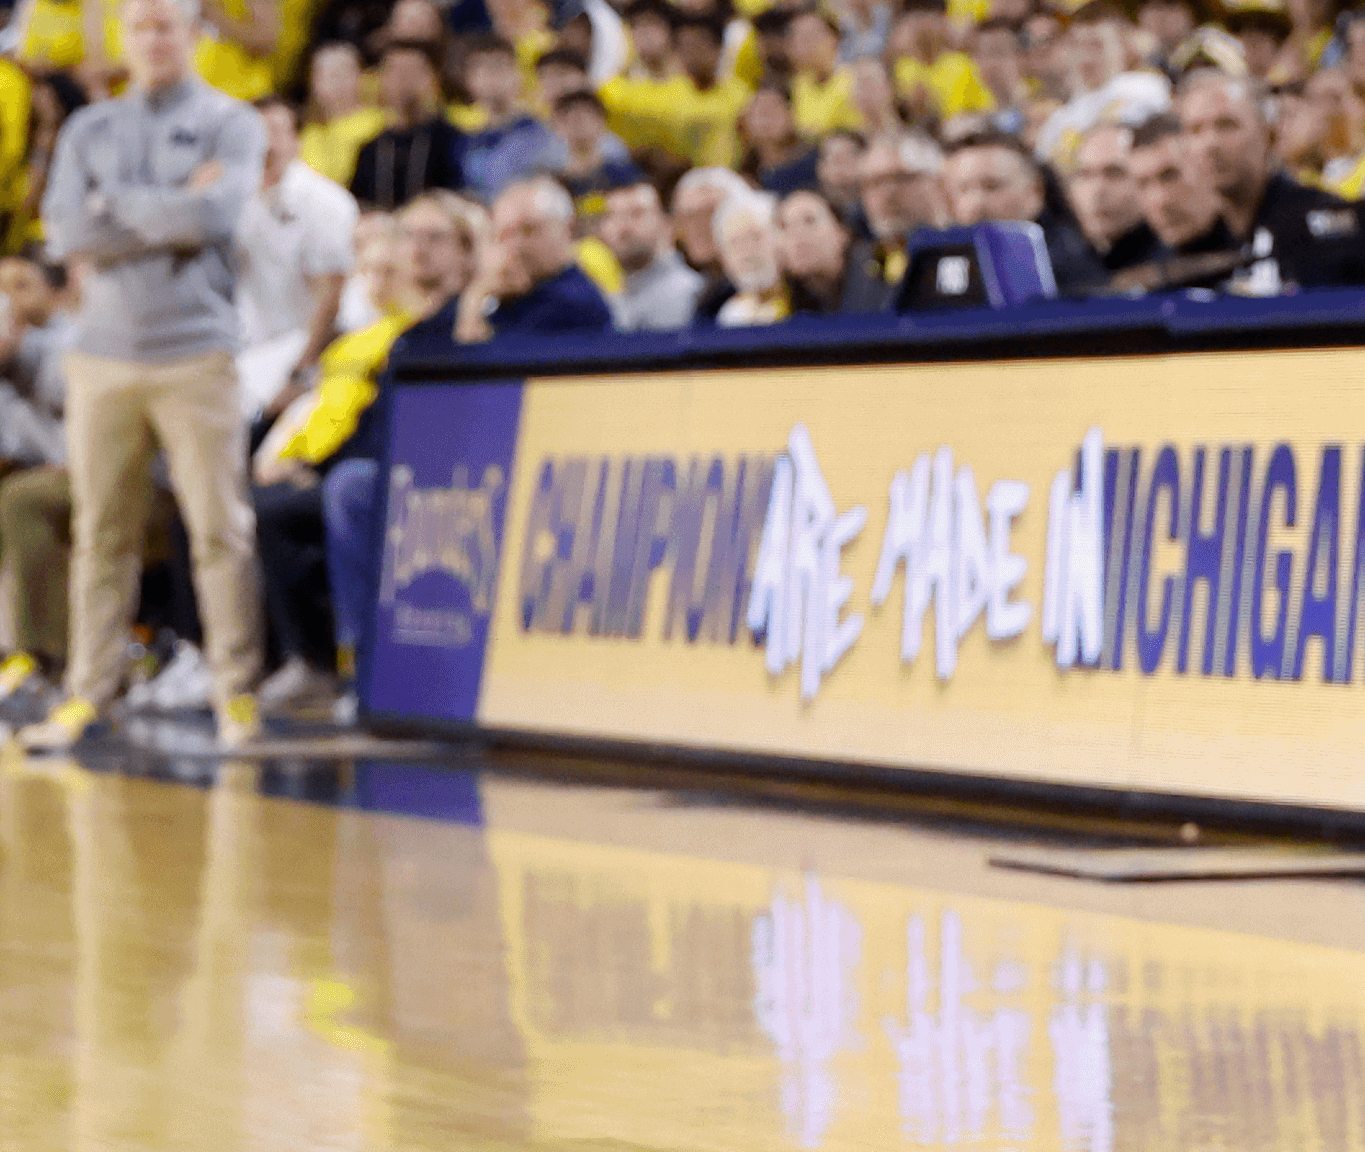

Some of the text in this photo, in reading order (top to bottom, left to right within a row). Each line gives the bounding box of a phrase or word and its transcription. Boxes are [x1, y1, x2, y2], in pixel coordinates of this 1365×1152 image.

[745, 418, 869, 701] ARE
[868, 442, 1034, 684] MADE
[1041, 425, 1106, 670] IN
